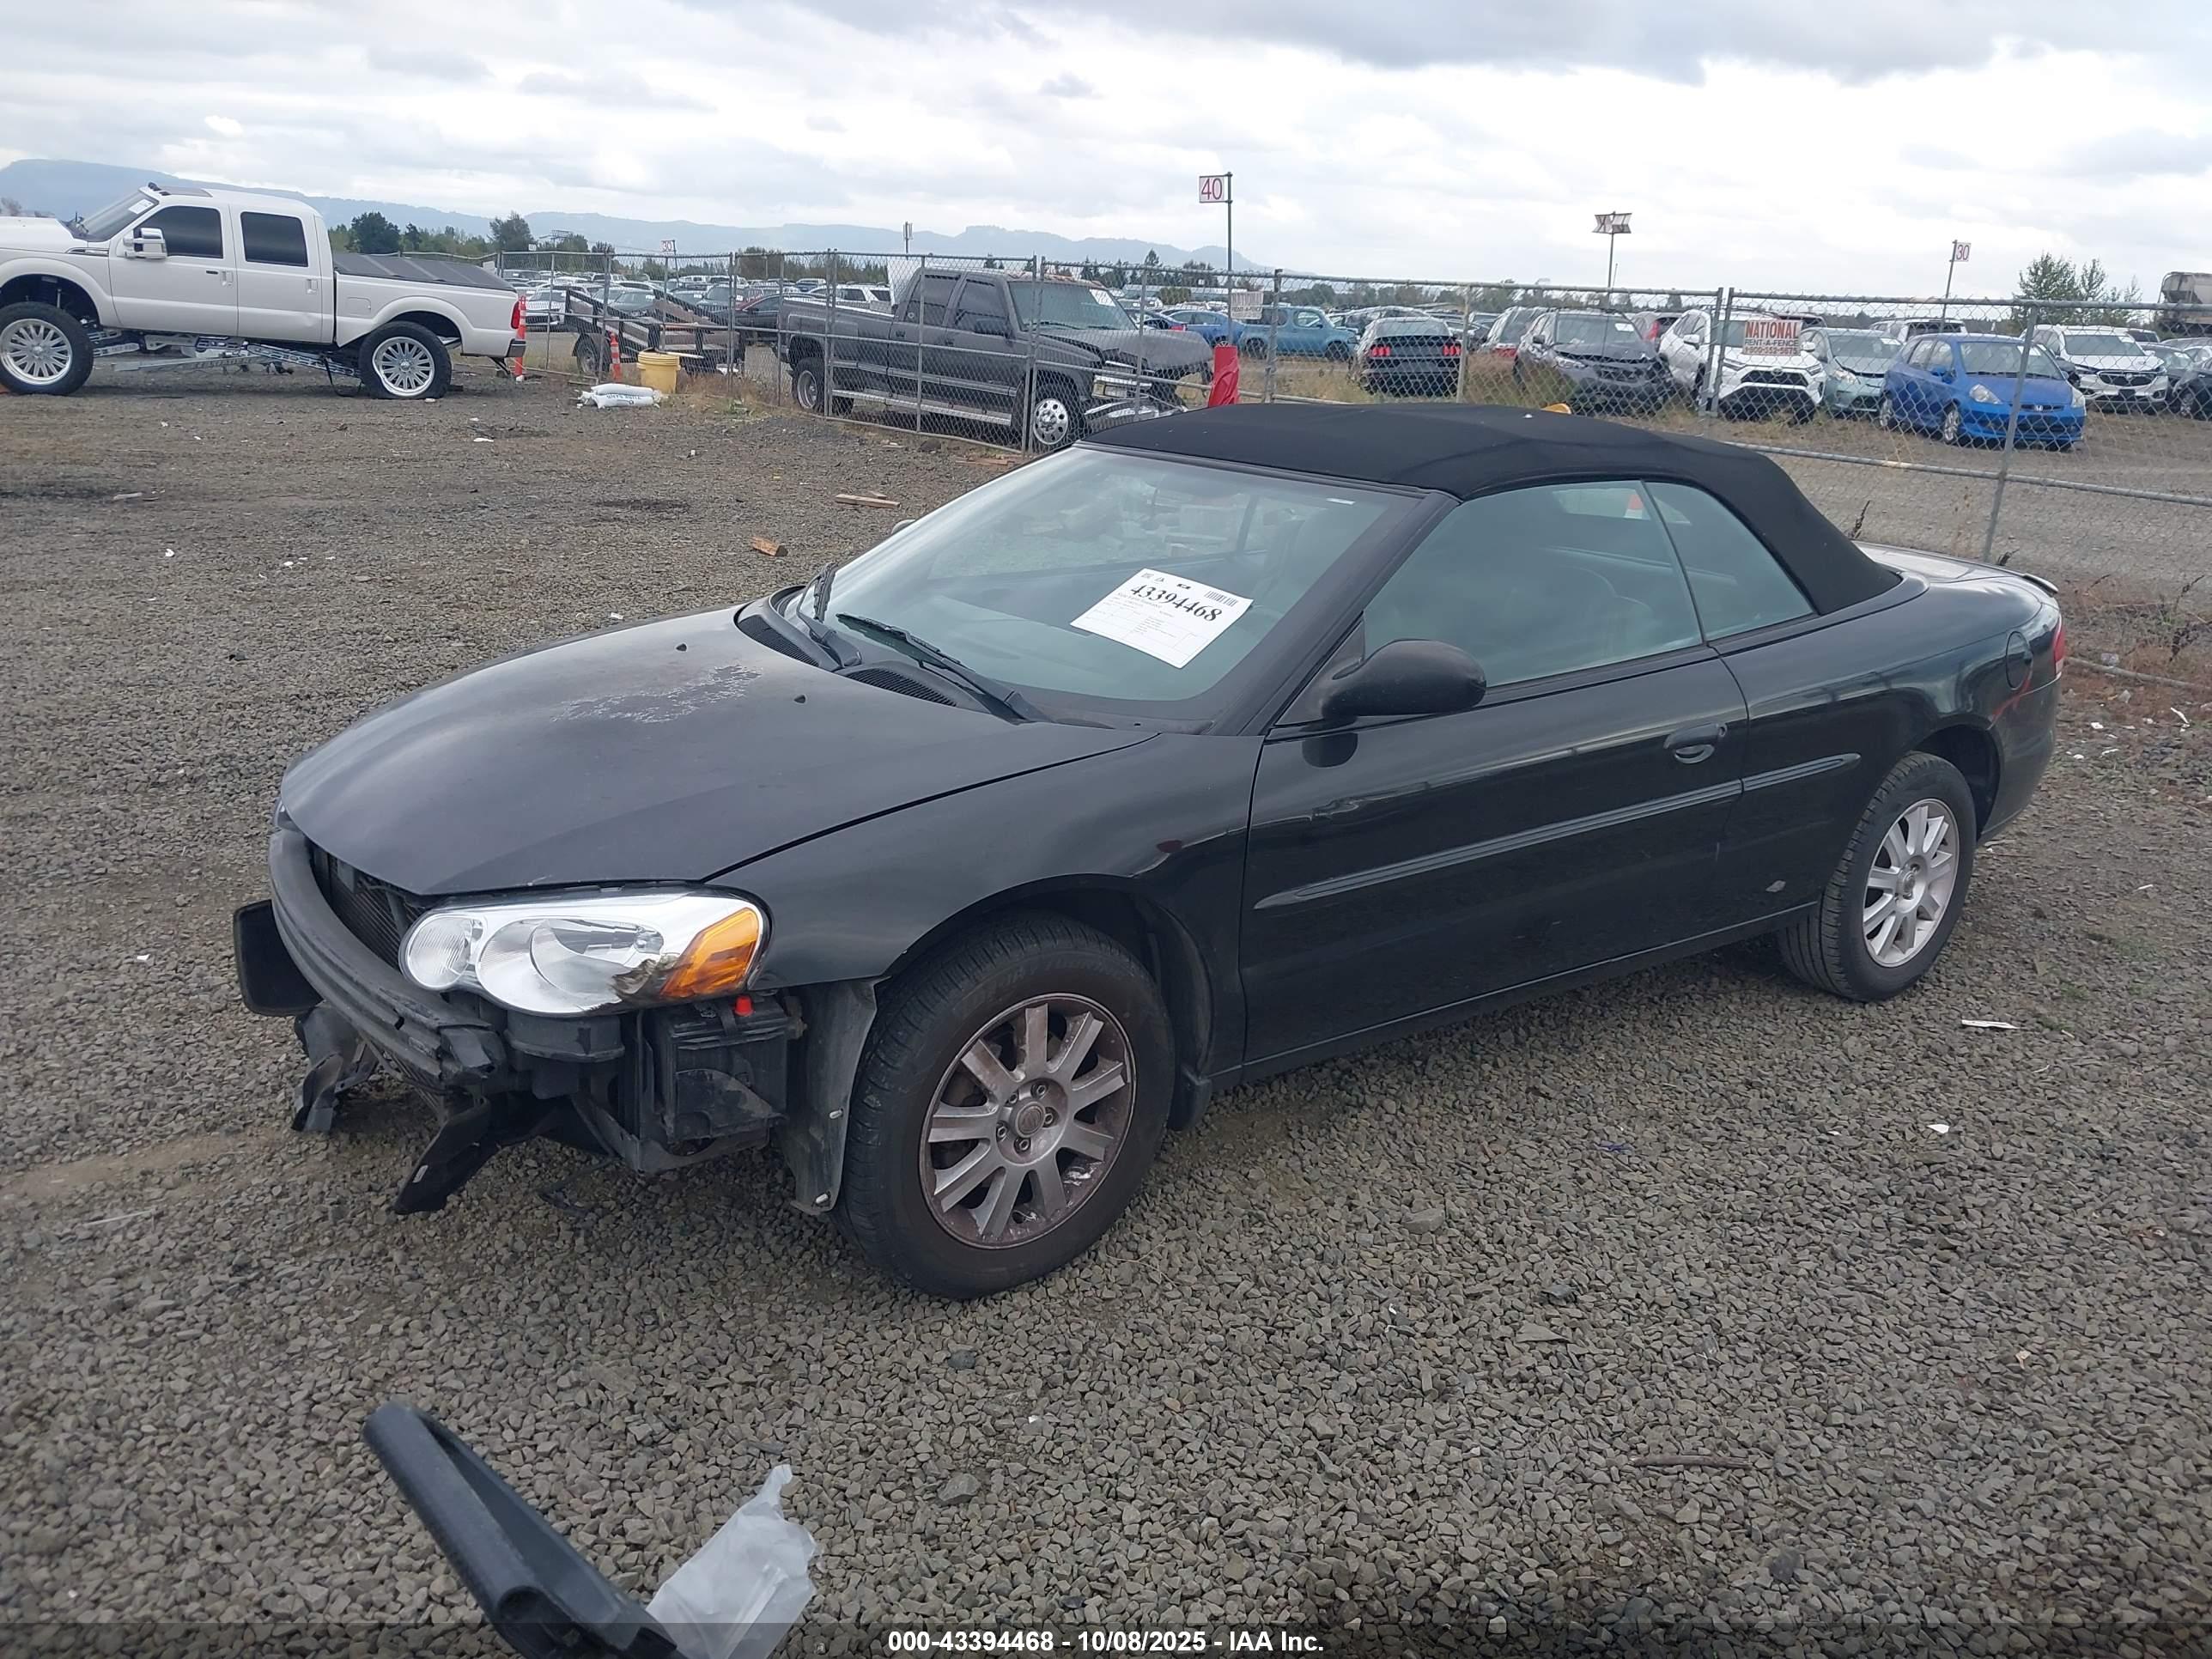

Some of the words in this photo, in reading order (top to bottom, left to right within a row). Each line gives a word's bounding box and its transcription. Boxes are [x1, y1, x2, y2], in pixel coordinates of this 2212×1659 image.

[1200, 178, 1223, 200] 40
[1955, 244, 1970, 261] 30
[1745, 321, 1799, 338] NATIONAL
[1131, 584, 1223, 622] 43394468
